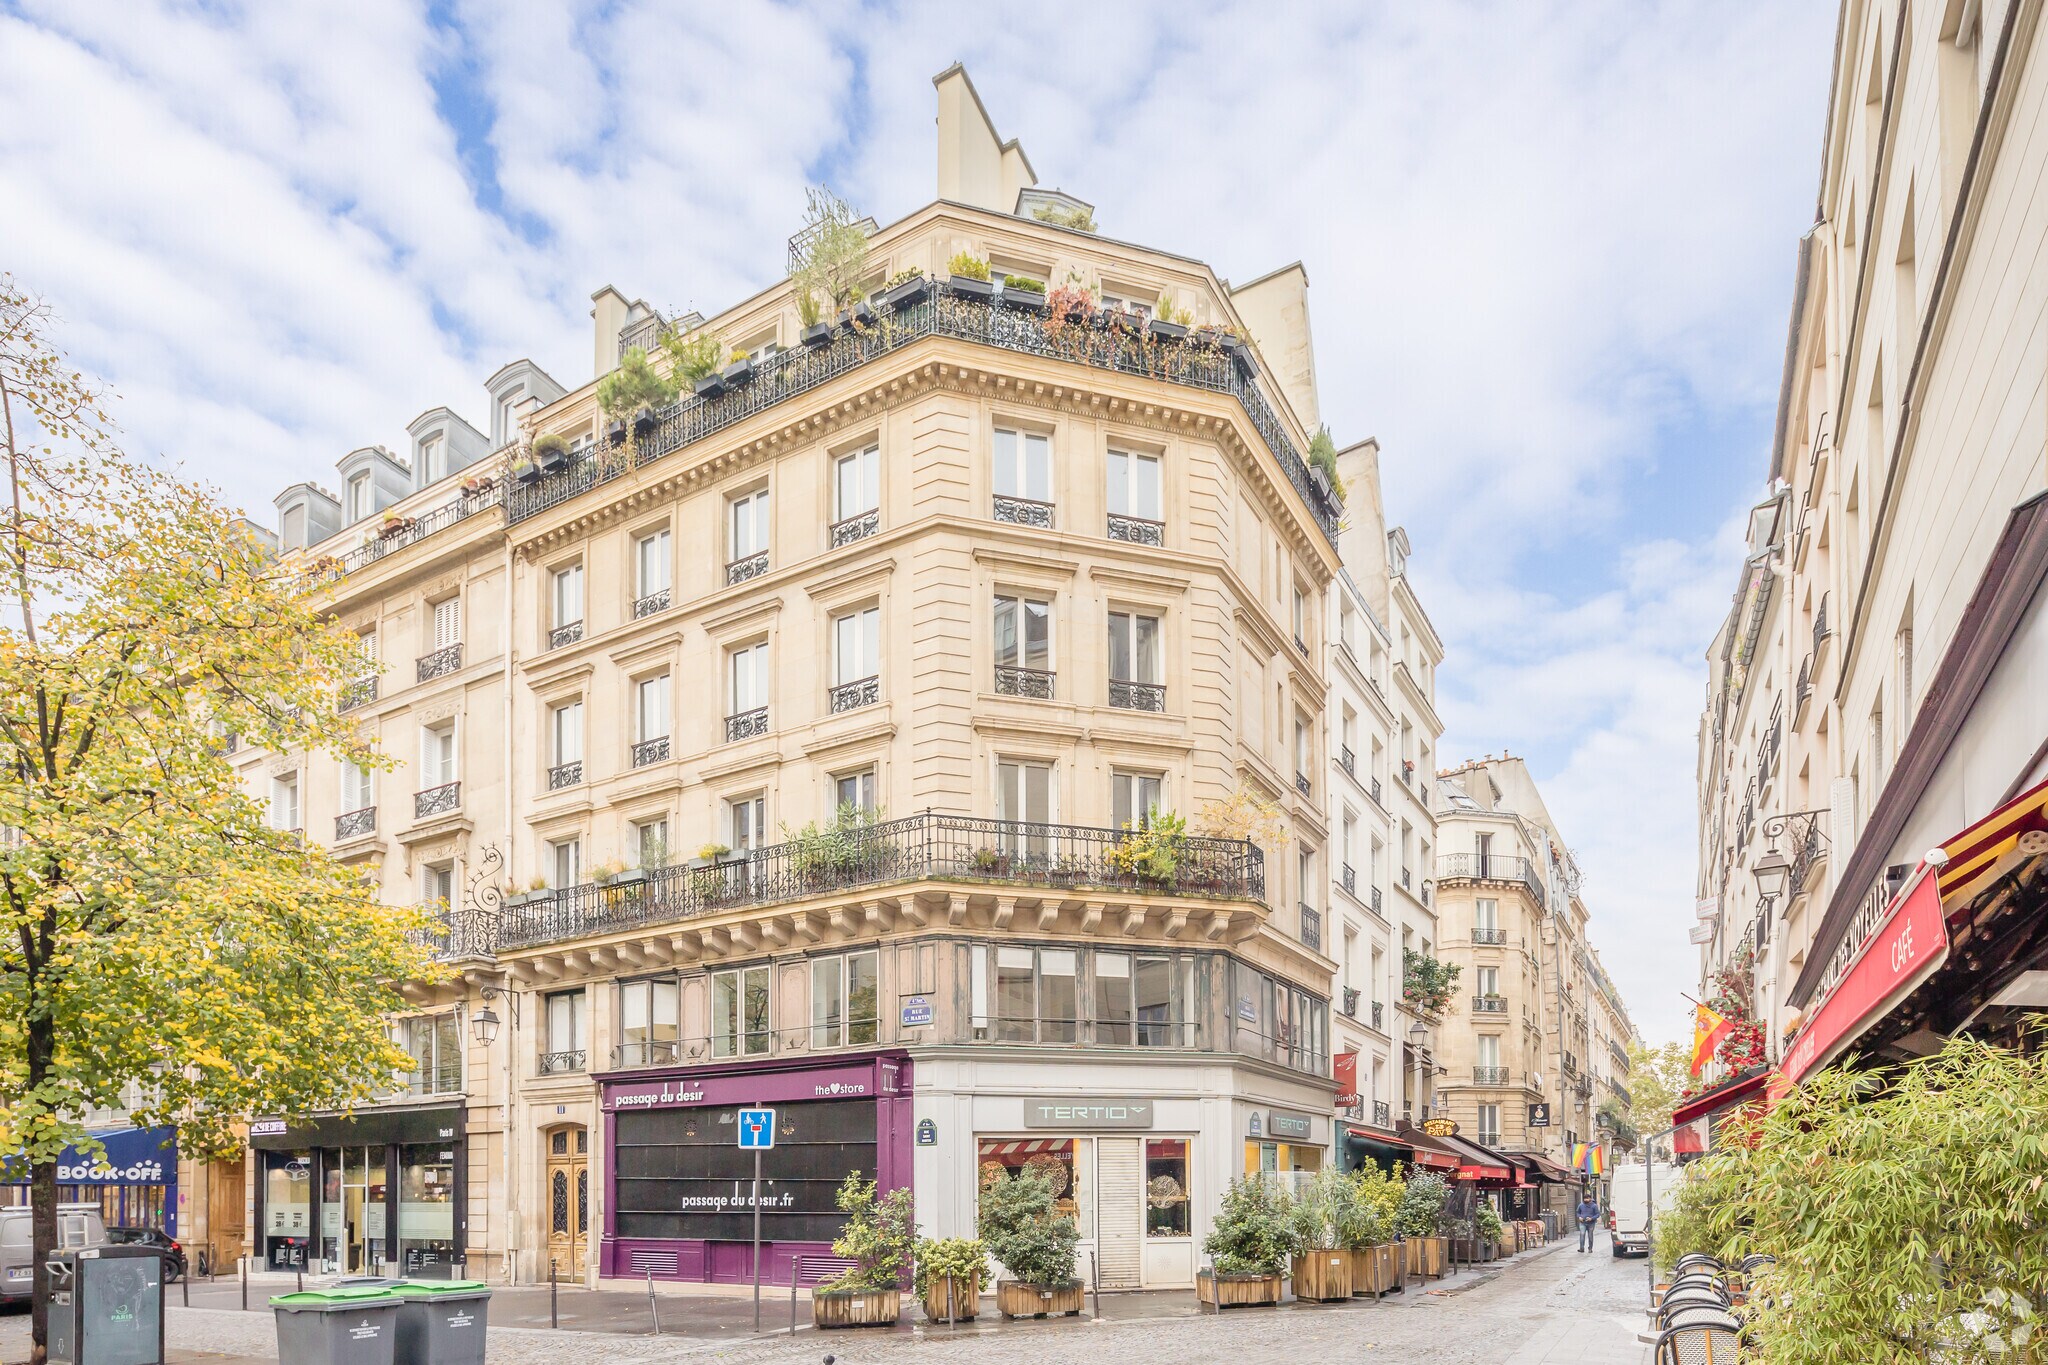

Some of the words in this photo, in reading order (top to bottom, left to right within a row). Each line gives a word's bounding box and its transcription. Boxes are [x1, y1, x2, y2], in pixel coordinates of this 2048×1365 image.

[1849, 866, 1890, 957] VOYELLES
[1892, 917, 1914, 973] CAFÉ
[615, 1094, 658, 1108] passage
[660, 1082, 674, 1103] du
[676, 1081, 704, 1102] desir
[1334, 1093, 1357, 1104] Birdy
[1038, 1106, 1127, 1119] TERTIO
[1423, 1119, 1455, 1128] RESTAURANT
[682, 1196, 728, 1212] passage
[730, 1181, 746, 1206] du
